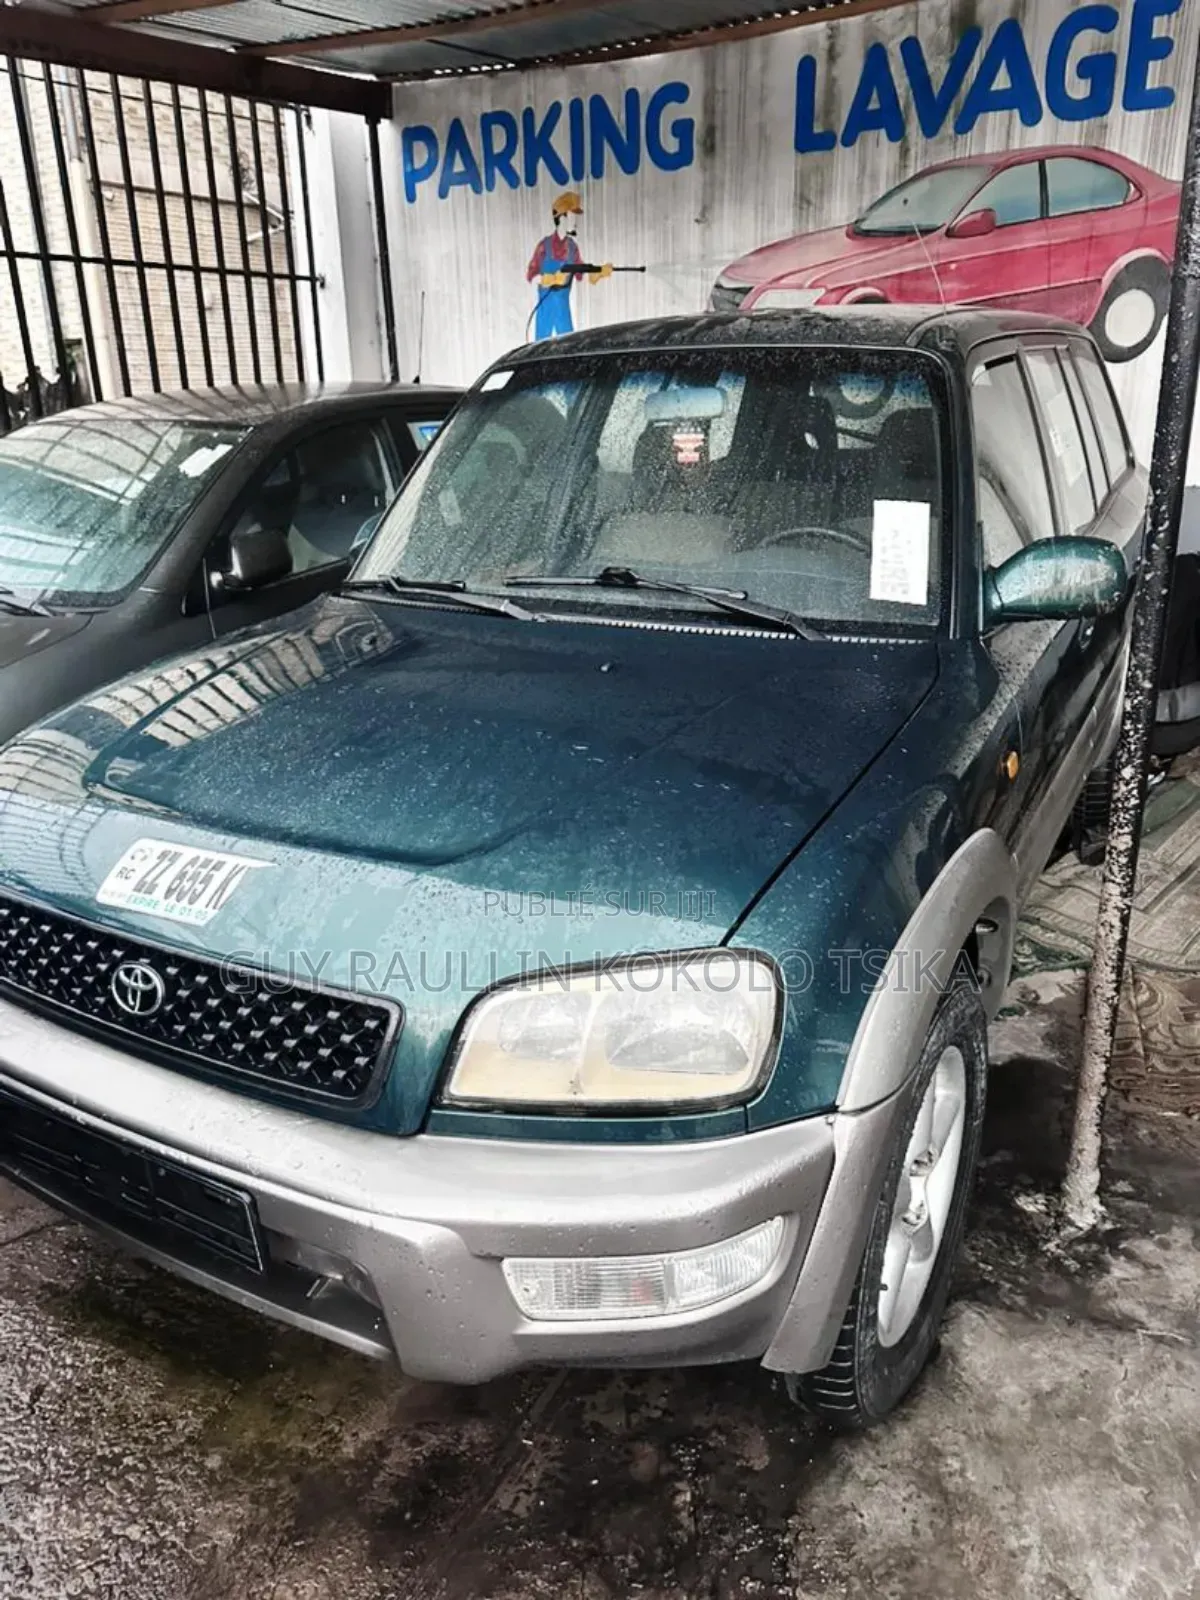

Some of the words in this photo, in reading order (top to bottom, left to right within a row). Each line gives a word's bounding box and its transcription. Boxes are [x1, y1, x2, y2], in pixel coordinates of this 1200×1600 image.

[402, 82, 694, 203] PARKING
[794, 0, 1184, 154] LAVAGE
[163, 855, 227, 906] 655
